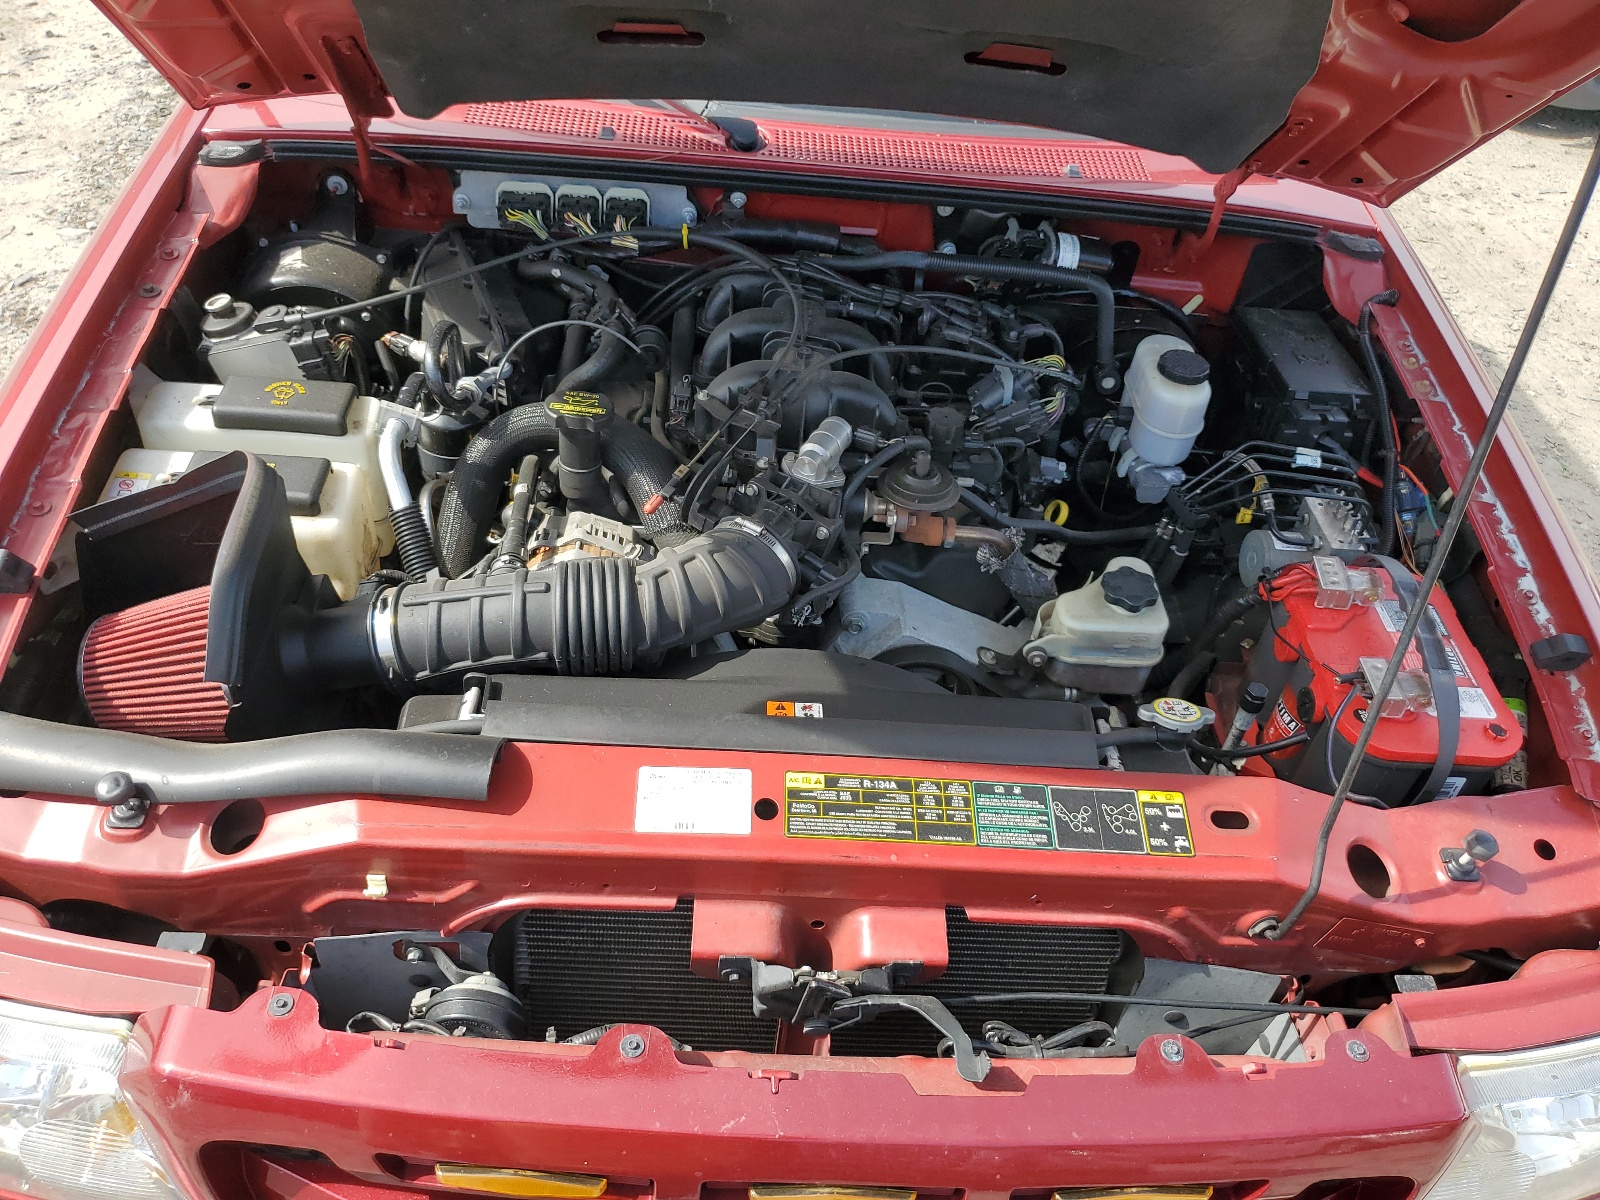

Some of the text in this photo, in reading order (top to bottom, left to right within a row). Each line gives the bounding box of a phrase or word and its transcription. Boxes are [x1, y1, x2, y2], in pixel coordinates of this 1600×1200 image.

[863, 779, 898, 789] R-134A
[1144, 807, 1162, 816] 50%
[1149, 837, 1169, 847] 50%
